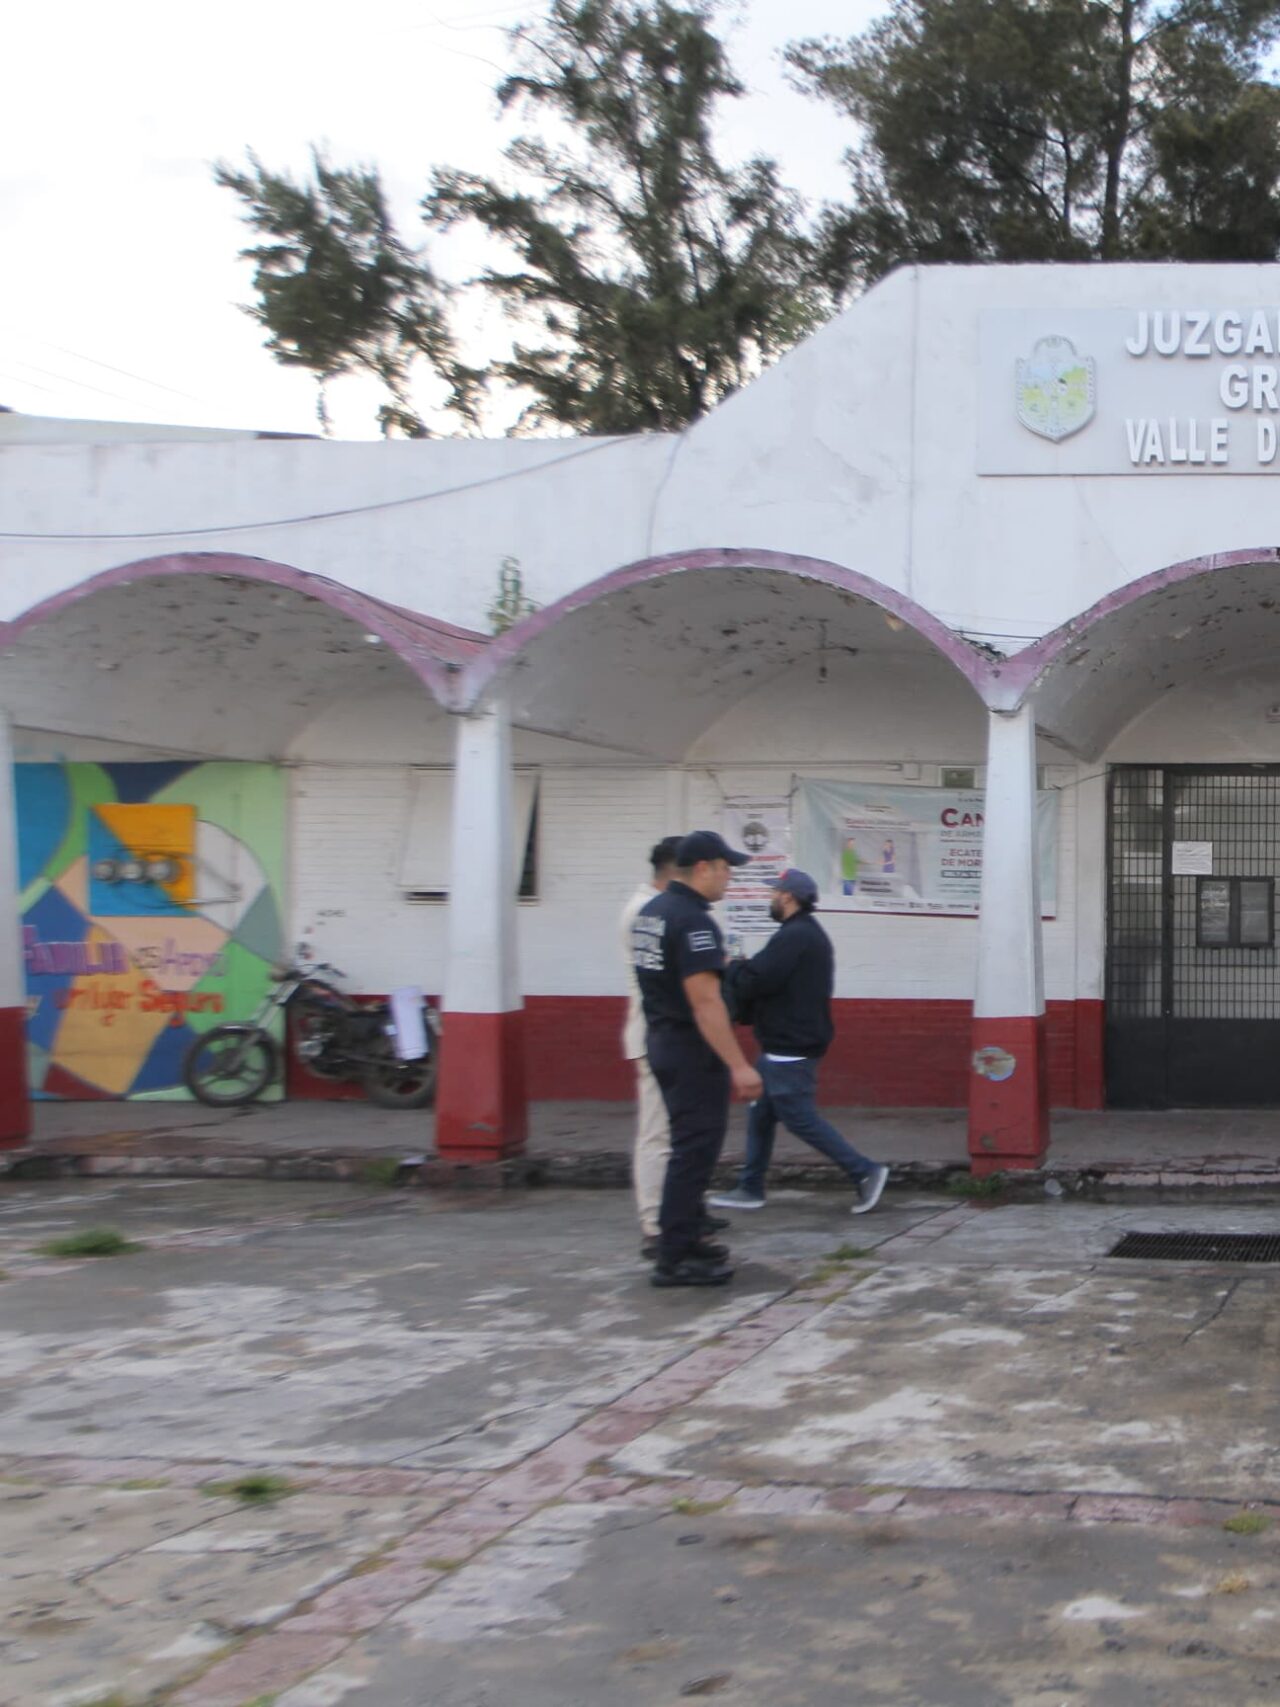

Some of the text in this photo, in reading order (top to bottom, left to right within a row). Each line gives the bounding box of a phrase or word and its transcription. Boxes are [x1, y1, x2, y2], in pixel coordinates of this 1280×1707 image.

[1126, 417, 1229, 465] VALLE
[949, 848, 984, 857] ECATE
[942, 858, 956, 867] DE
